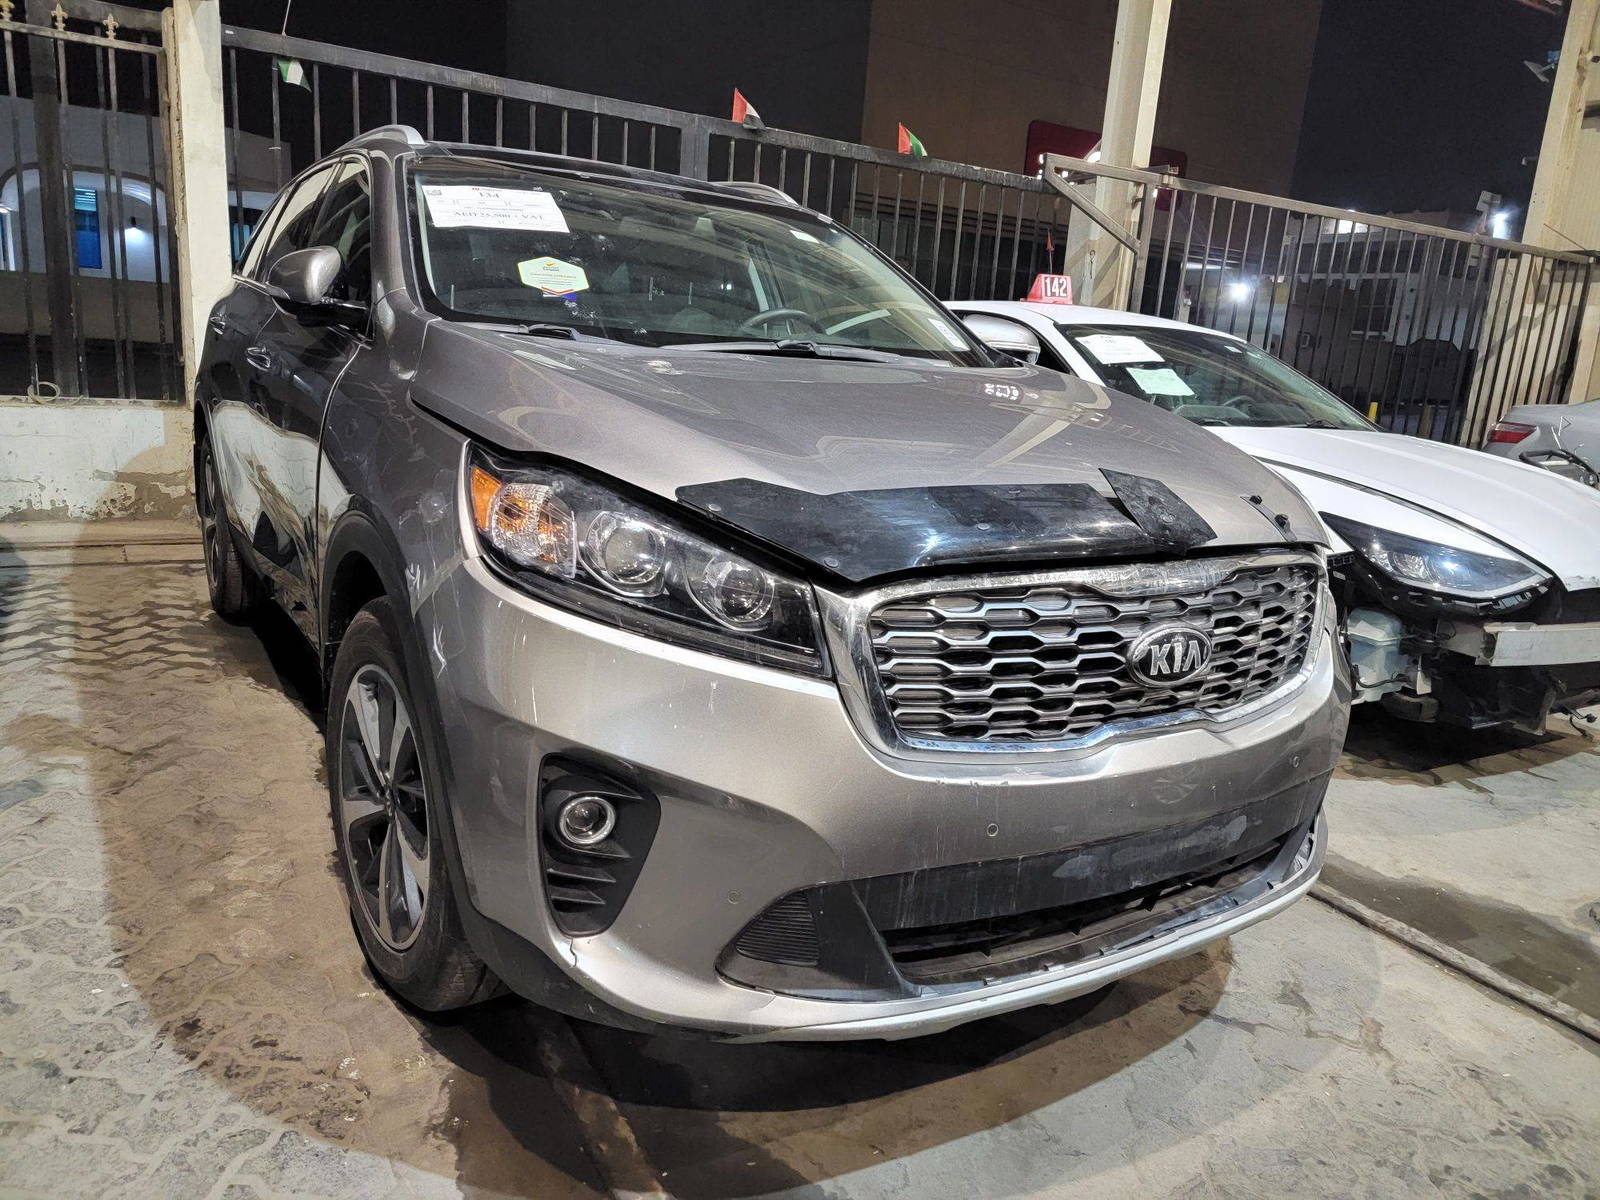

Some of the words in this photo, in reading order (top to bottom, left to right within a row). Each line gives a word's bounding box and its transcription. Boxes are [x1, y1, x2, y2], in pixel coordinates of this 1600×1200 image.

[521, 213, 544, 221] VAT
[1045, 277, 1067, 297] 142
[1150, 640, 1201, 676] KIA
